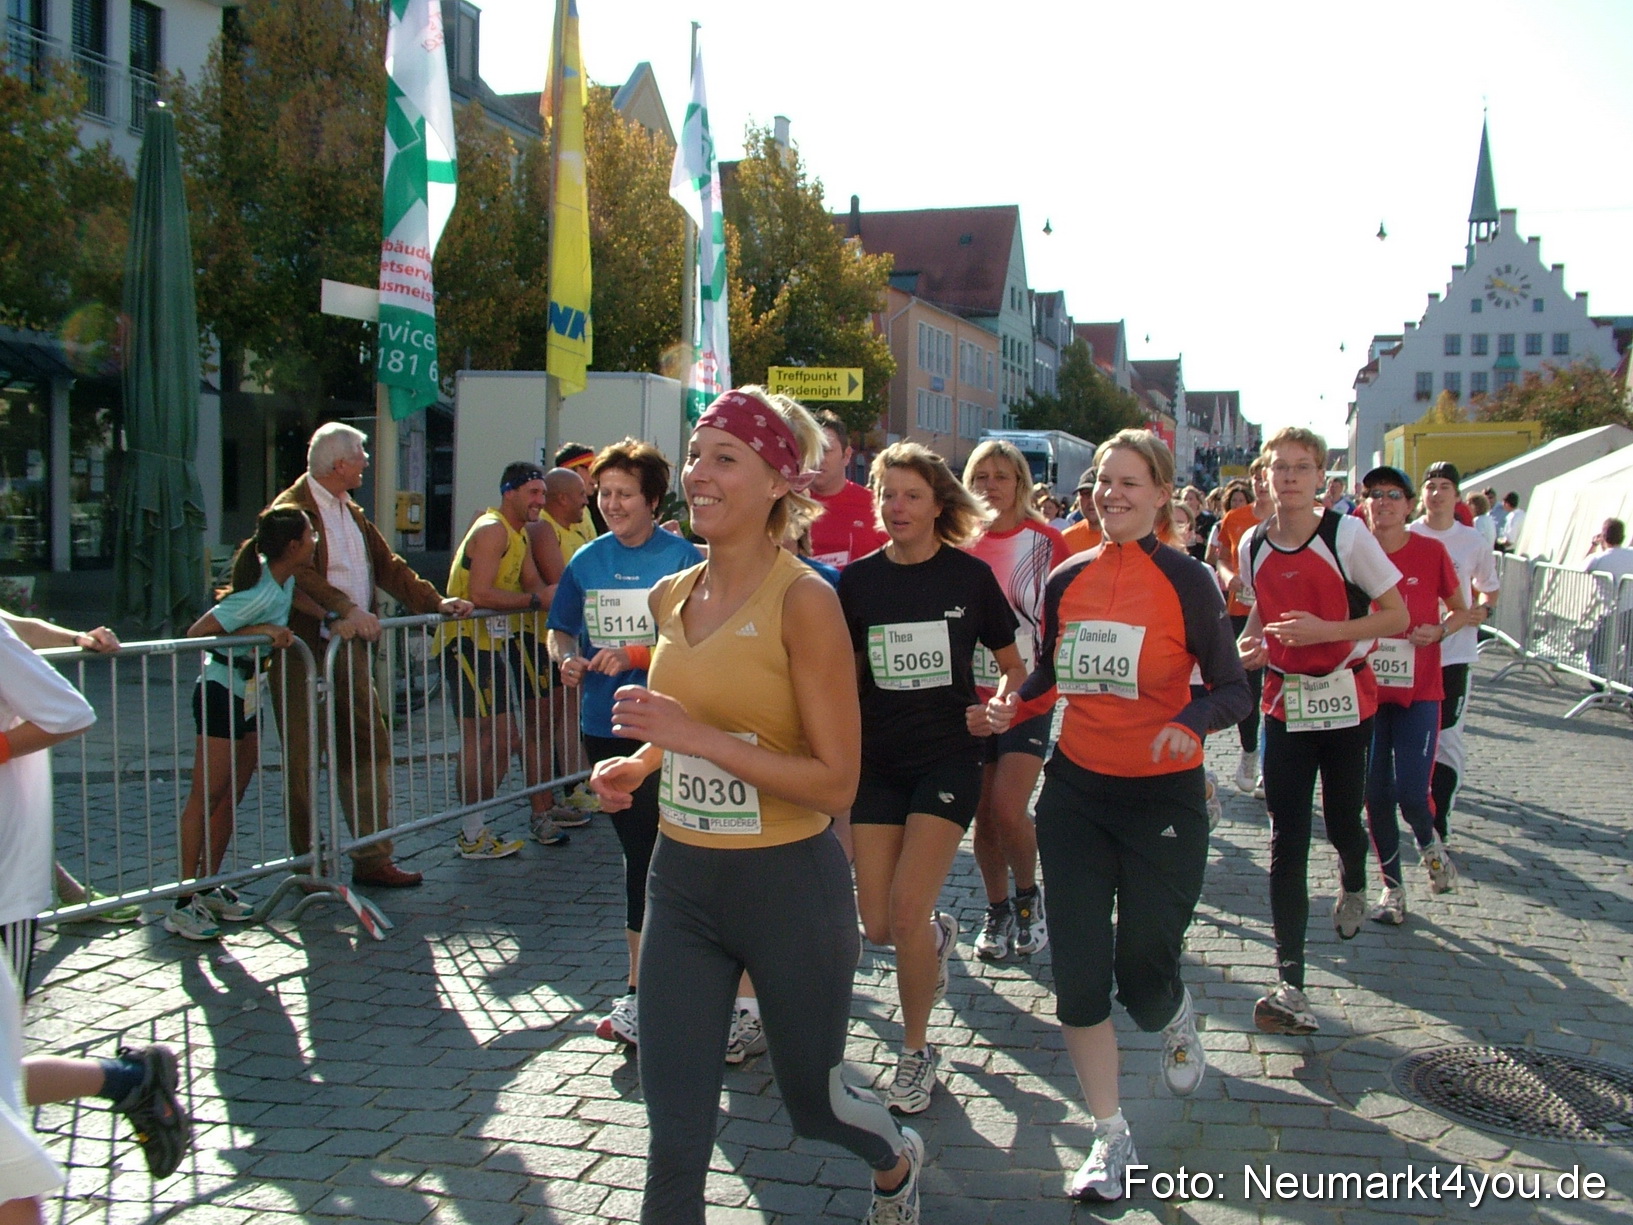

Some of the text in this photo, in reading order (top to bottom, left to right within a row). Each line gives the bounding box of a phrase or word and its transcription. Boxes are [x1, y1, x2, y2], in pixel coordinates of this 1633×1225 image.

[776, 370, 838, 382] Treffpunkt
[600, 595, 621, 607] Erna
[603, 615, 648, 633] 5114
[889, 630, 913, 643] Thea
[1080, 628, 1117, 643] Daniela
[894, 650, 944, 672] 5069
[1078, 654, 1130, 678] 5149
[1372, 659, 1408, 673] 5051
[1303, 680, 1330, 692] Julian
[1308, 696, 1352, 714] 5093
[678, 772, 747, 806] 5030
